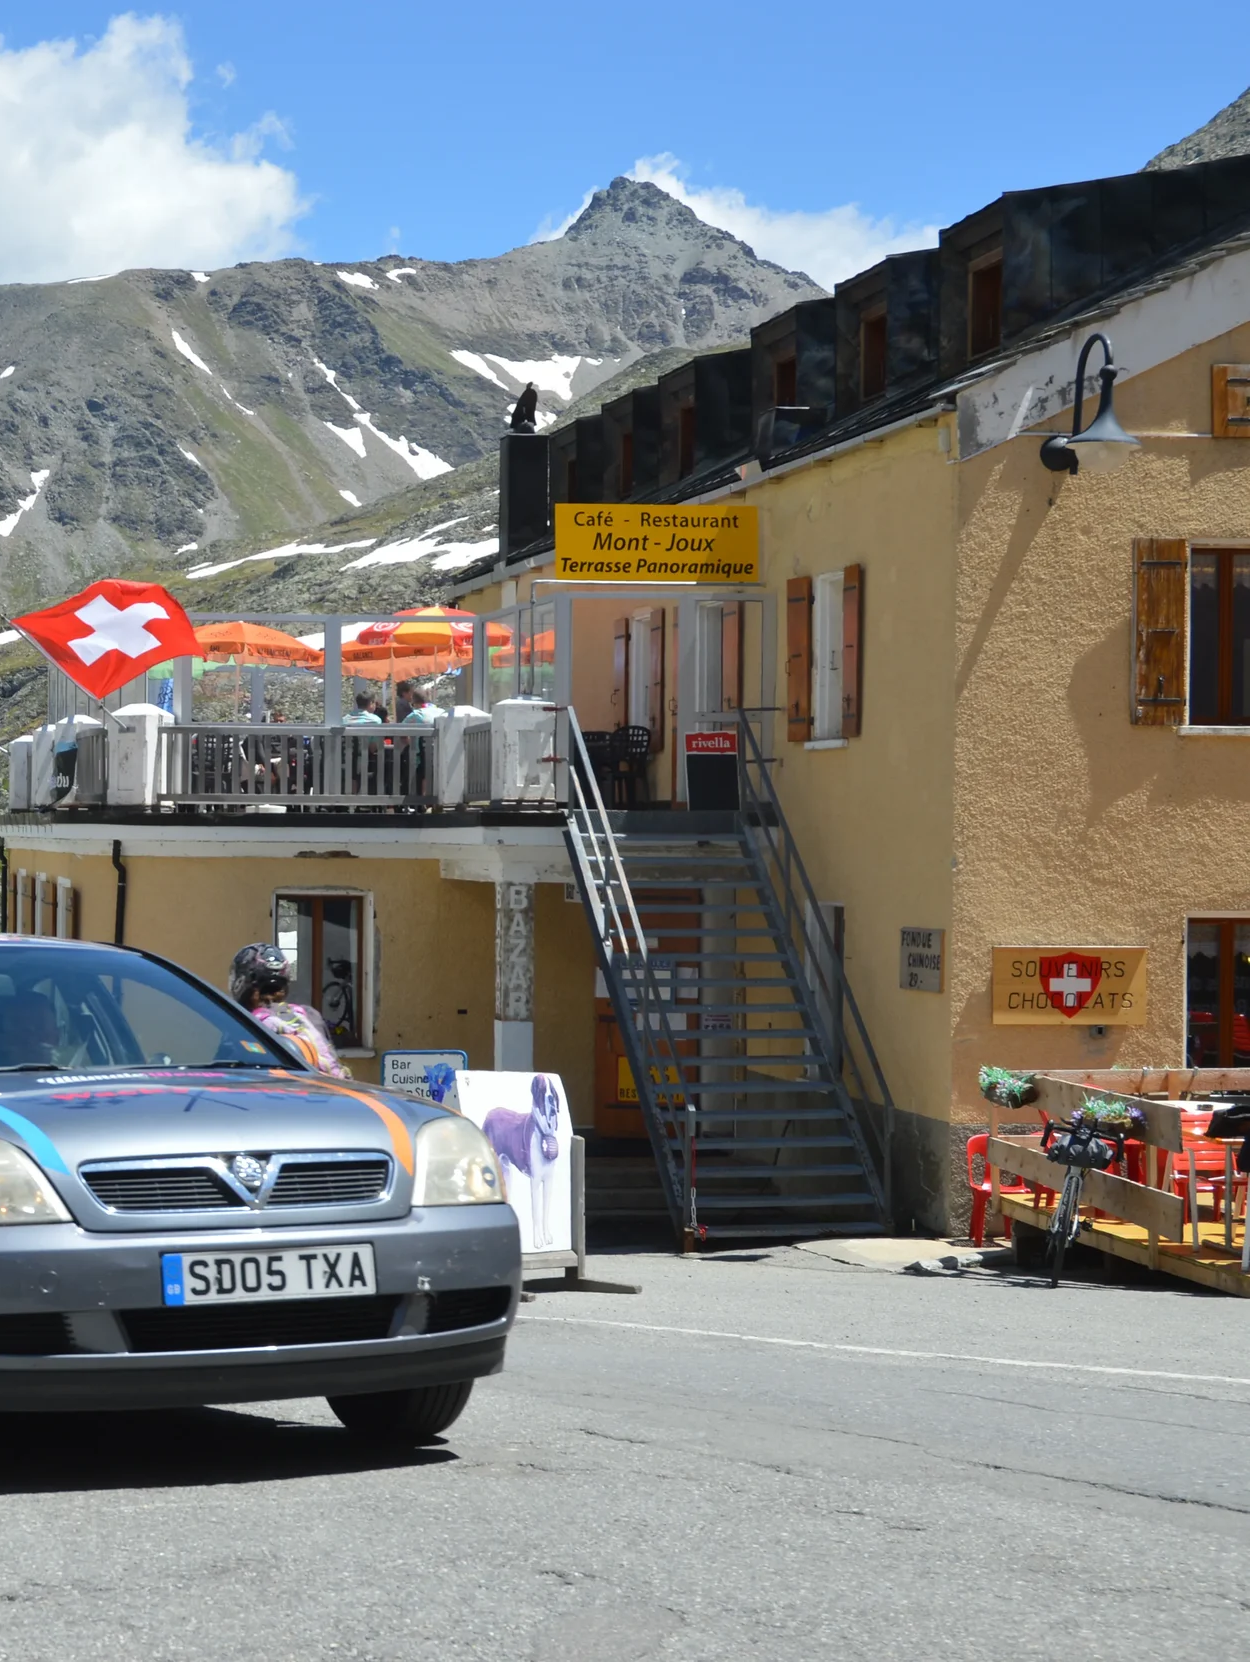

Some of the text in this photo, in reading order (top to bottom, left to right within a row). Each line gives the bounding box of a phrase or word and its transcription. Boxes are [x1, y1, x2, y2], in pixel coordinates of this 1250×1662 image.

[574, 511, 613, 527] Café
[641, 512, 739, 528] Restaurant
[593, 532, 649, 551] Mont
[665, 533, 715, 552] Joux
[561, 557, 754, 578] Terrasse Panoramique
[691, 737, 731, 748] rivella
[901, 931, 932, 949] FONDUE
[507, 885, 529, 1020] BAZAR
[908, 952, 941, 970] CHINOISE
[1011, 960, 1126, 979] SOUVENIRS
[1008, 992, 1134, 1009] CHOCOLATS
[392, 1059, 411, 1070] Bar
[392, 1073, 429, 1084] Cuisine
[188, 1251, 368, 1296] SD05 TXA
[166, 1283, 181, 1295] GB
